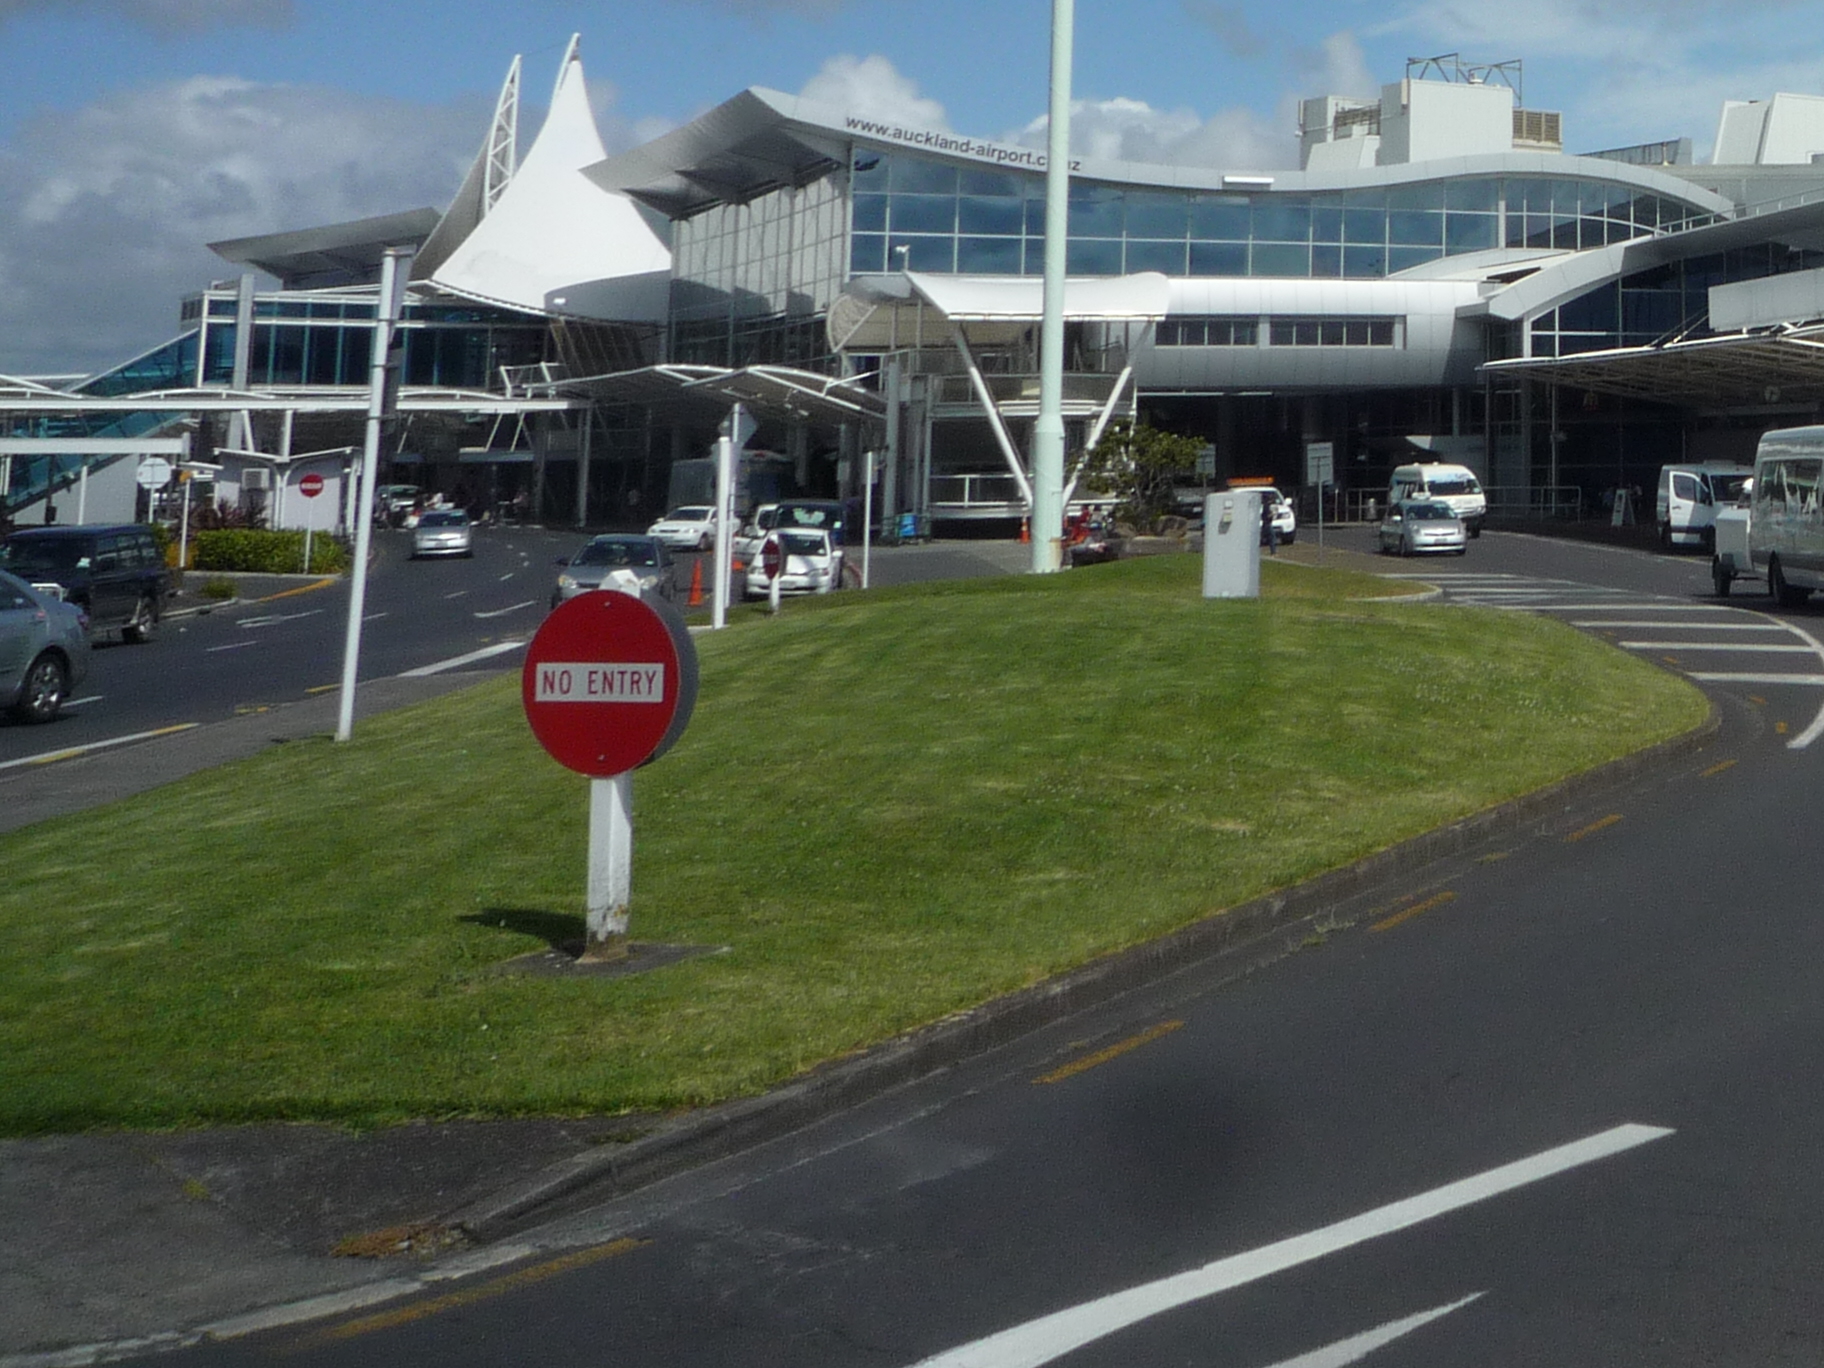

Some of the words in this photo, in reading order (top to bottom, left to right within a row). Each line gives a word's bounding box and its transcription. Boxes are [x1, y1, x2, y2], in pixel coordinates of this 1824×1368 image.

[846, 116, 1081, 172] www.auckland-airport.cz
[542, 669, 572, 695] NO
[588, 670, 657, 695] ENTRY
